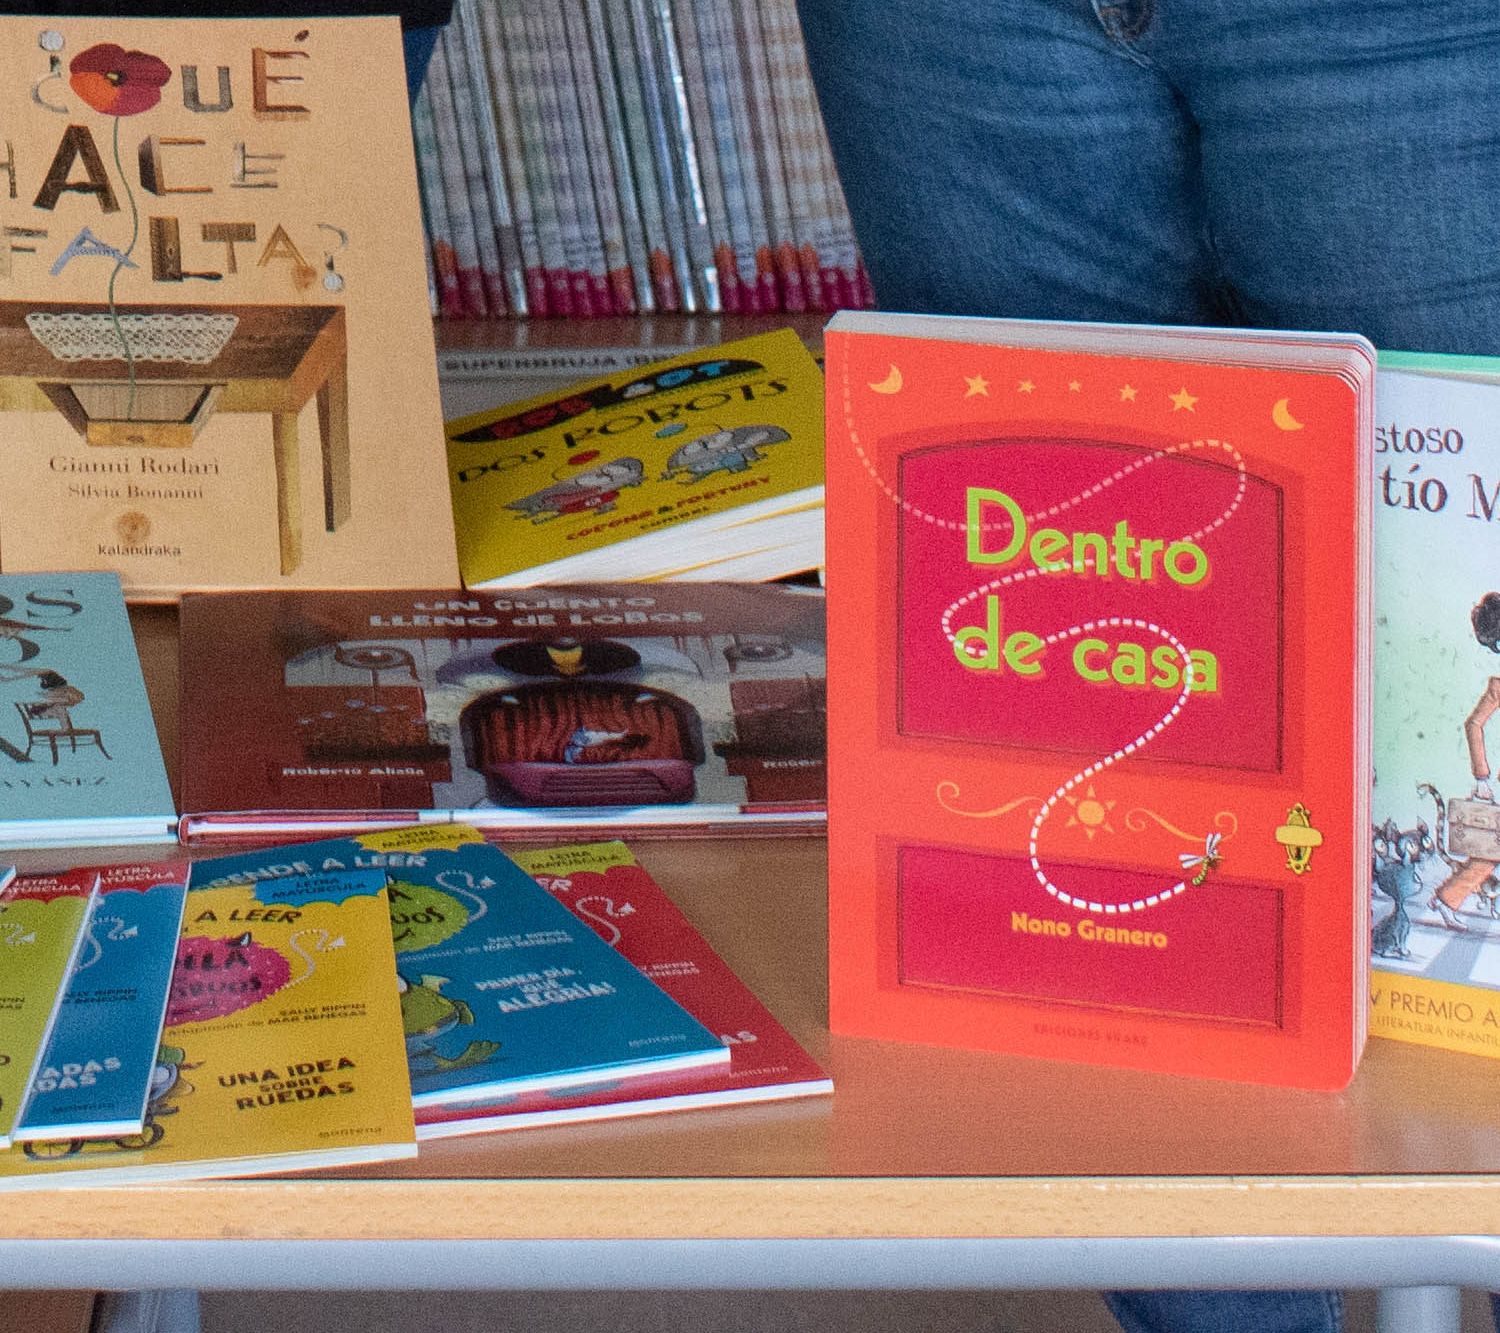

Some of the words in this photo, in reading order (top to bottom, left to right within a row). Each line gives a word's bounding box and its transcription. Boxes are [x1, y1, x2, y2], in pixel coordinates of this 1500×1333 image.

[563, 377, 790, 449] ROBOTS
[49, 455, 130, 475] Gianni
[139, 457, 220, 476] Rodari
[67, 483, 120, 499] Silvia
[126, 484, 204, 500] Bonanni
[1378, 462, 1449, 513] tío
[965, 485, 1209, 586] Dentro
[97, 543, 182, 558] kalandraka
[413, 599, 480, 612] UN
[495, 595, 657, 611] CUENTO
[369, 612, 496, 627] LLENO
[953, 594, 1043, 675] de
[1071, 633, 1219, 693] casa
[322, 857, 345, 870] A
[354, 854, 428, 868] LEER
[296, 876, 340, 888] LETRA
[195, 910, 218, 923] A
[229, 907, 303, 924] LEER
[1010, 910, 1072, 939] Nono
[1076, 920, 1168, 950] Granero
[1390, 989, 1474, 1023] PREMIO
[1446, 1028, 1500, 1048] INFANTIL
[217, 1068, 280, 1089] UNA
[286, 1056, 356, 1077] IDEA
[259, 1075, 325, 1094] SOBRE
[235, 1081, 356, 1111] RUEDAS
